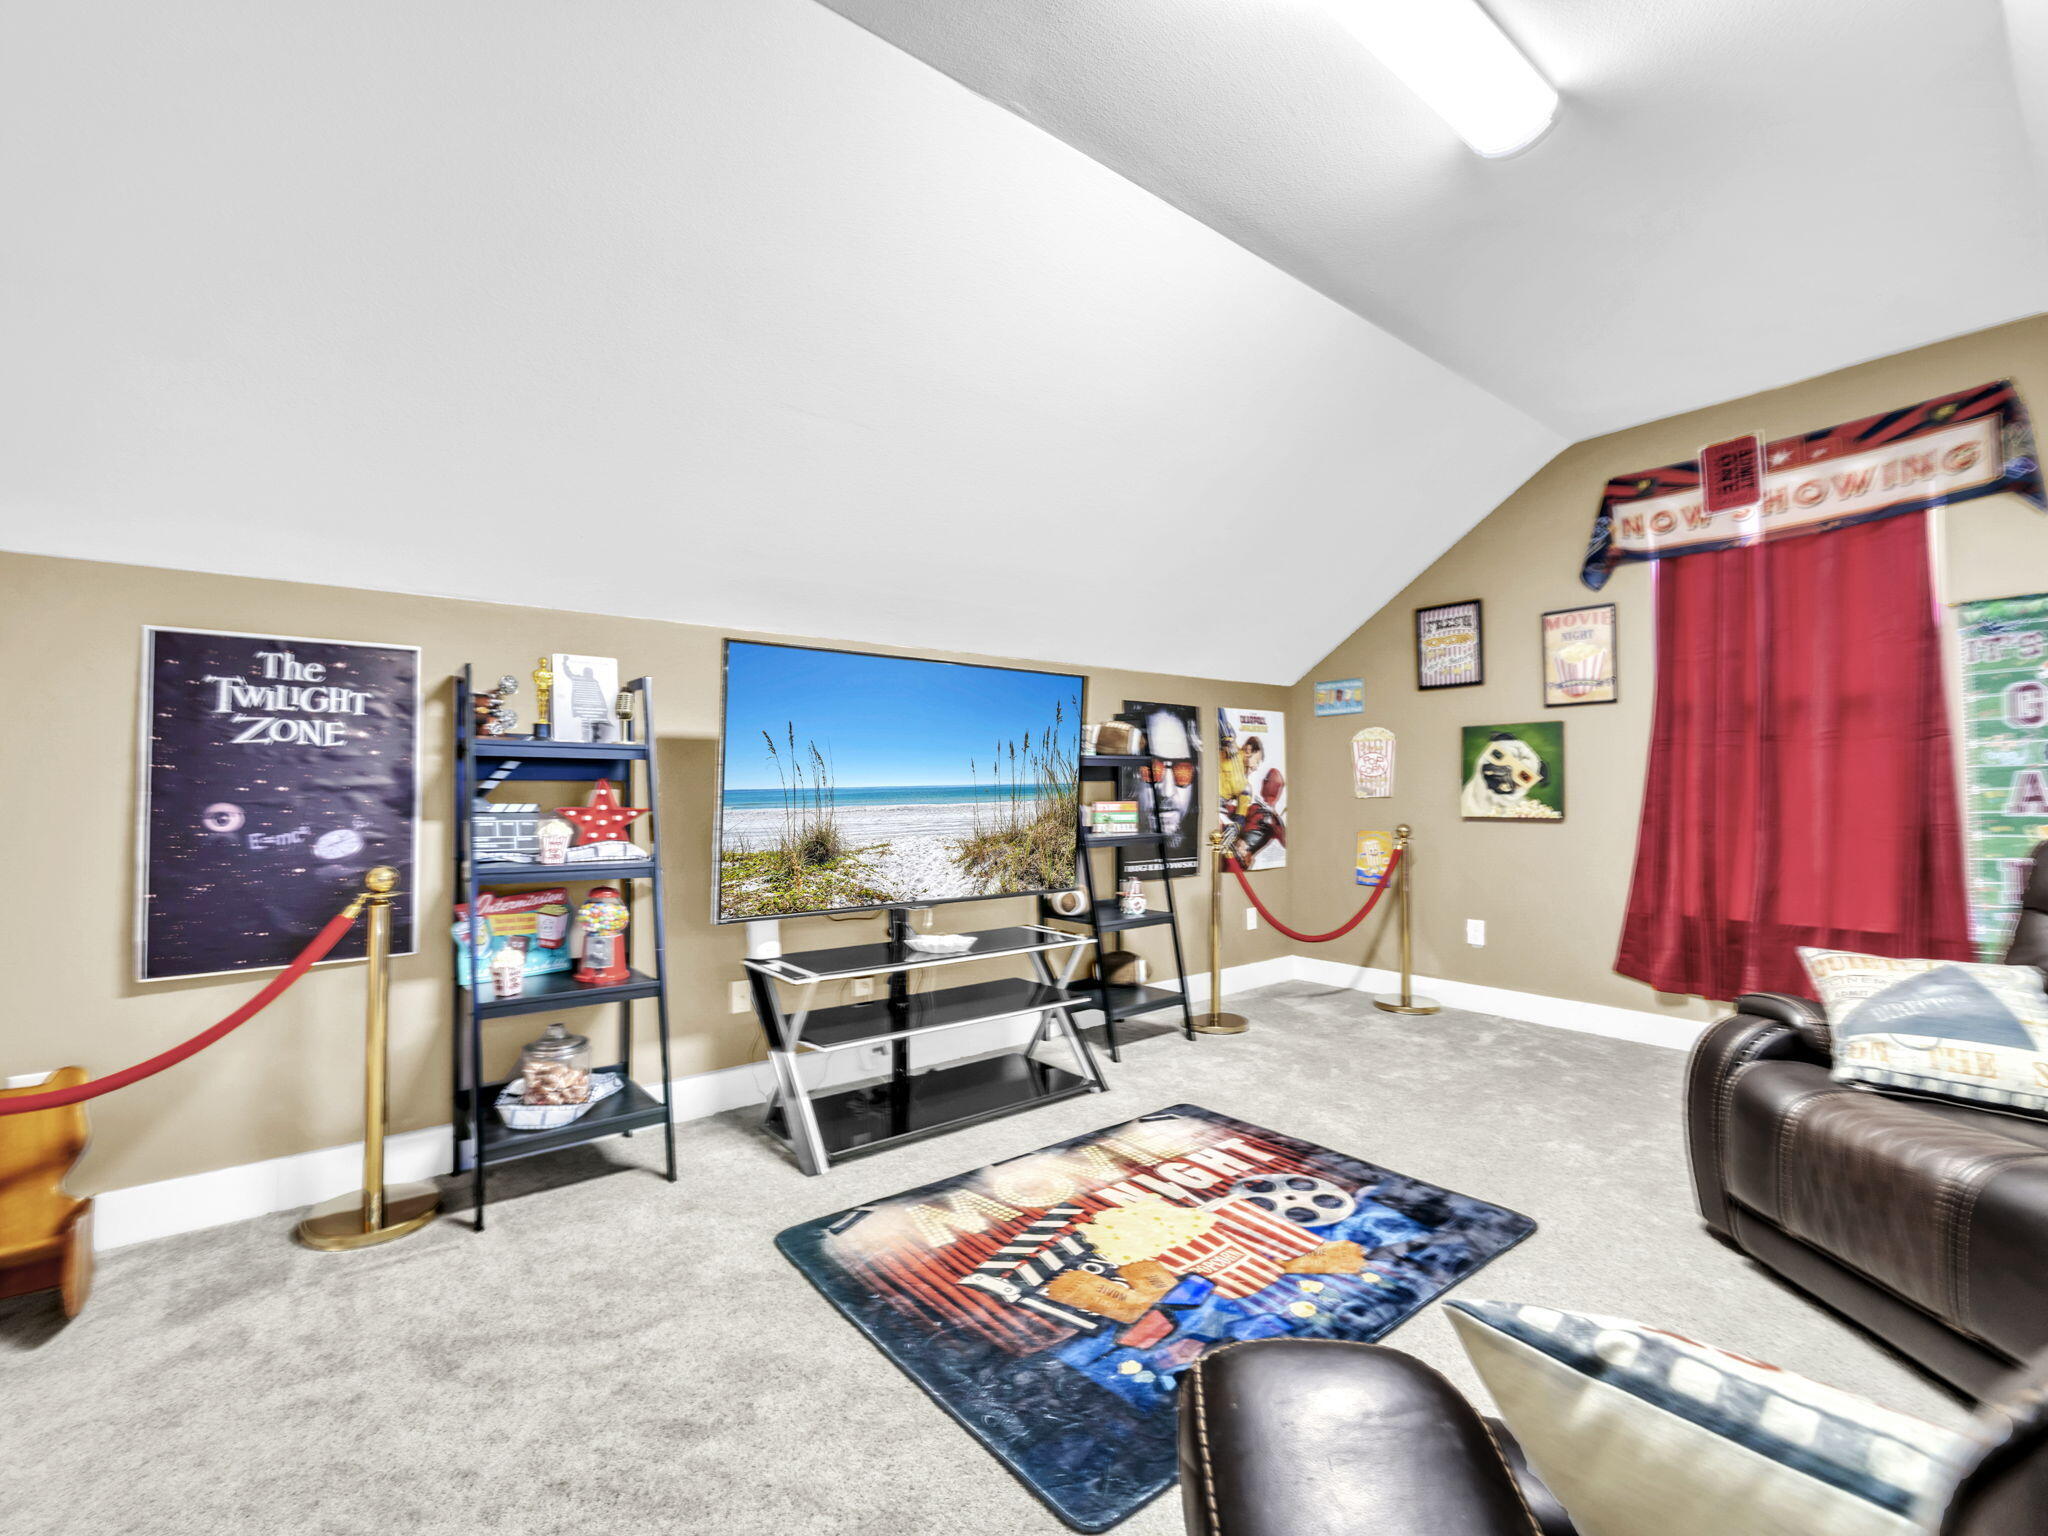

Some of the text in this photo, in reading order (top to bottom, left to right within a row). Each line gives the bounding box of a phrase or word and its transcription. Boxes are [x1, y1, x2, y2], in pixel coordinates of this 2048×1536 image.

[1542, 610, 1612, 633] MOVIE
[1560, 628, 1594, 642] NIGHT
[253, 651, 326, 683] The
[230, 713, 348, 748] ZONE
